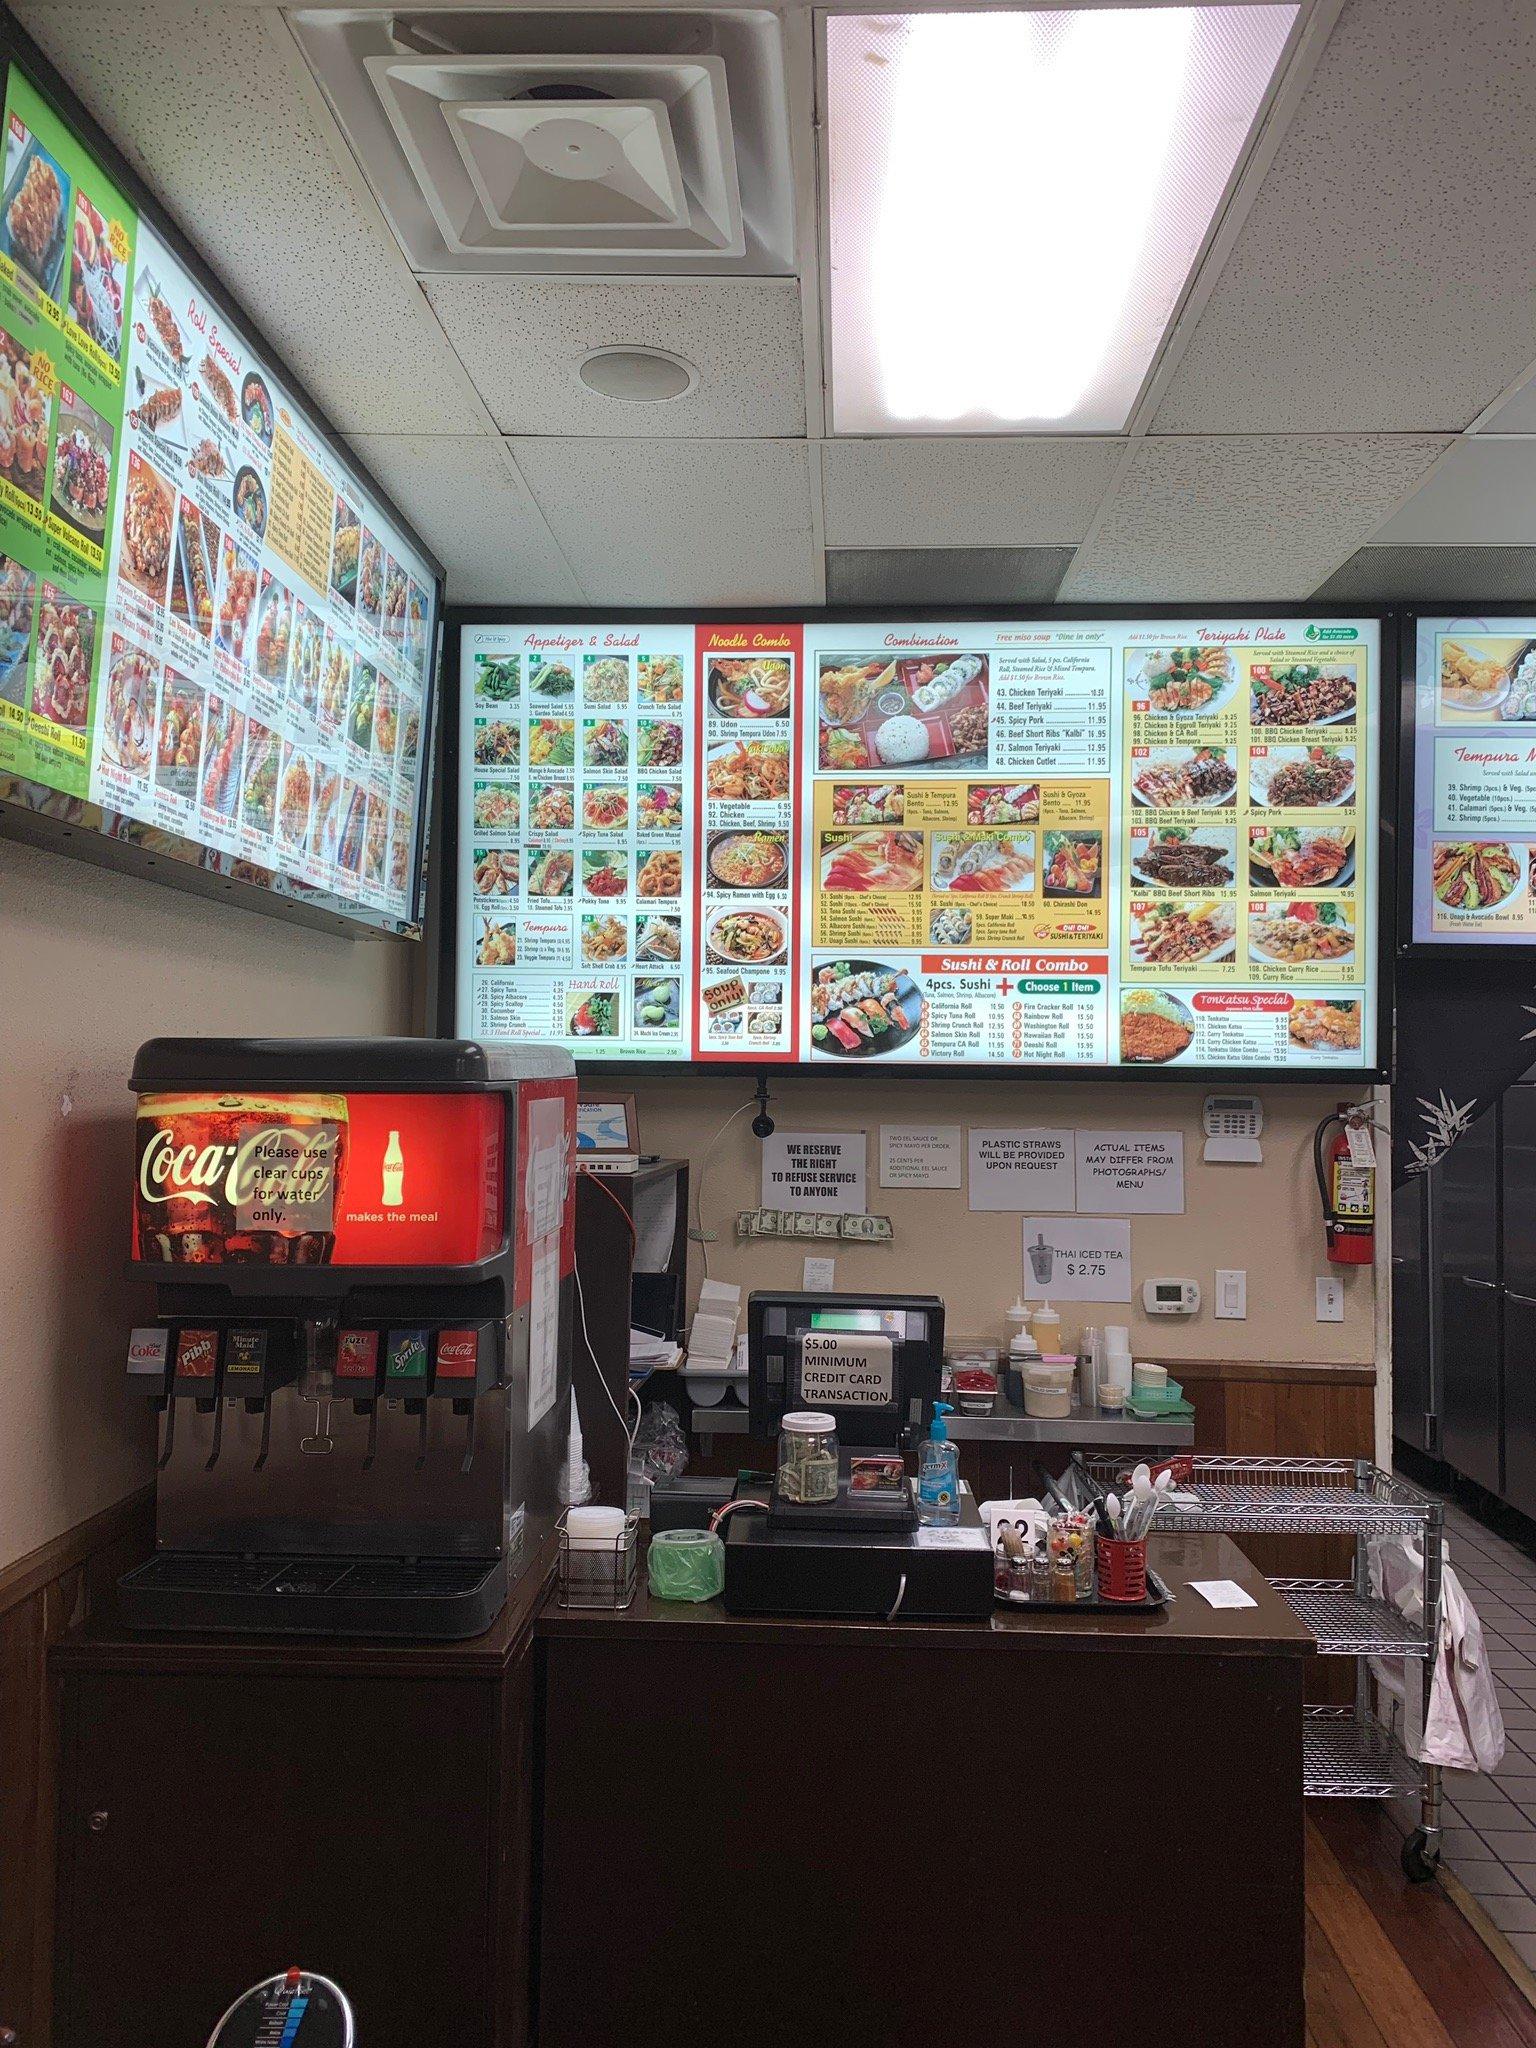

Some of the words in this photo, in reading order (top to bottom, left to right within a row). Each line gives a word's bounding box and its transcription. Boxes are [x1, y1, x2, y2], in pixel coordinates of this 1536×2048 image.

[114, 225, 124, 242] NO
[110, 234, 127, 258] RICE
[208, 326, 242, 375] Special
[38, 357, 50, 372] NO
[33, 367, 53, 390] RICE
[524, 632, 583, 650] Appetizer
[589, 634, 597, 646] &
[603, 632, 640, 647] Salad
[708, 633, 748, 647] Noodle
[752, 632, 791, 647] Combo
[883, 633, 959, 646] Combination
[1033, 634, 1050, 642] soup
[1197, 628, 1250, 645] Teriyaki
[1255, 628, 1286, 640] Plate
[996, 688, 1007, 697] 43.
[1009, 688, 1035, 696] Chicken
[1038, 688, 1063, 698] Teriyaki
[996, 702, 1007, 710] 44.
[1009, 702, 1024, 710] Beef
[1027, 702, 1052, 712] Teriyaki
[1088, 702, 1106, 710] 11.95
[997, 716, 1006, 724] 45.
[1008, 716, 1027, 726] Spicy
[1029, 716, 1044, 724] Pork
[1088, 716, 1106, 724] 11.95
[996, 729, 1007, 738] 46.
[1009, 729, 1024, 738] Beef
[1026, 729, 1044, 738] Short
[1046, 729, 1060, 738] Ribs
[996, 743, 1006, 752] 47.
[1009, 743, 1033, 752] Salmon
[1035, 743, 1061, 753] Teriyaki
[996, 757, 1006, 766] 48.
[1008, 757, 1034, 766] Chicken
[1036, 757, 1056, 766] Cutlet
[1088, 757, 1106, 766] 11.95
[1455, 747, 1519, 766] Tempura
[1459, 784, 1482, 793] Shrimp
[1460, 794, 1490, 802] Vegetable
[720, 802, 750, 811] Vegetable
[825, 833, 853, 842] Sushi
[523, 921, 568, 934] Tempura
[941, 959, 982, 971] Sushi
[986, 960, 998, 971] &
[1002, 959, 1030, 971] Roll
[1036, 959, 1088, 971] Combo
[569, 977, 598, 989] Hand
[926, 979, 955, 991] 4pcs.
[960, 979, 991, 990] Sushi
[1025, 982, 1059, 992] Choose
[1063, 982, 1068, 991] 1
[1072, 982, 1094, 992] Item
[1251, 994, 1289, 1010] Special
[787, 1145, 801, 1155] WE
[803, 1144, 841, 1155] RESERVE
[982, 1140, 1020, 1149] PLASTIC
[1022, 1140, 1061, 1149] STRAWS
[1093, 1144, 1130, 1152] ACTUAL
[1134, 1144, 1165, 1153] ITEMS
[255, 1145, 299, 1158] Please
[303, 1149, 328, 1158] use
[979, 1150, 1000, 1159] WILL
[1003, 1150, 1015, 1159] BE
[1018, 1150, 1064, 1160] PROVIDED
[791, 1158, 808, 1169] THE
[810, 1158, 837, 1169] RIGHT
[986, 1161, 1011, 1170] UPON
[1014, 1161, 1058, 1171] REQUEST
[1086, 1156, 1106, 1164] MAY
[1109, 1156, 1143, 1165] DIFFER
[1147, 1156, 1173, 1165] FROM
[140, 1128, 339, 1207] Coca-Cola
[1093, 1168, 1166, 1177] PHOTOGRAPHS/
[253, 1166, 287, 1179] clear
[291, 1169, 323, 1183] cups
[772, 1172, 783, 1183] TO
[785, 1172, 819, 1183] REFUSE
[819, 1172, 857, 1183] SERVICE
[1117, 1181, 1144, 1189] MENU
[254, 1187, 273, 1200] for
[277, 1188, 319, 1200] water
[790, 1186, 801, 1197] TO
[803, 1186, 838, 1197] ANYONE
[252, 1207, 286, 1224] only.
[346, 1210, 383, 1221] makes
[387, 1210, 405, 1221] the
[410, 1210, 438, 1221] meal
[1055, 1250, 1076, 1259] THAI
[1079, 1250, 1101, 1259] ICED
[1104, 1250, 1123, 1260] TEA
[1067, 1264, 1074, 1276] $
[1079, 1264, 1106, 1276] 2.75
[805, 1338, 837, 1350] $5.00
[131, 1344, 160, 1357] Coke
[182, 1339, 212, 1366] Pibb
[394, 1340, 423, 1370] Sprite
[805, 1356, 867, 1367] MINIMUM
[805, 1372, 846, 1383] CREDIT
[849, 1374, 881, 1384] CARD
